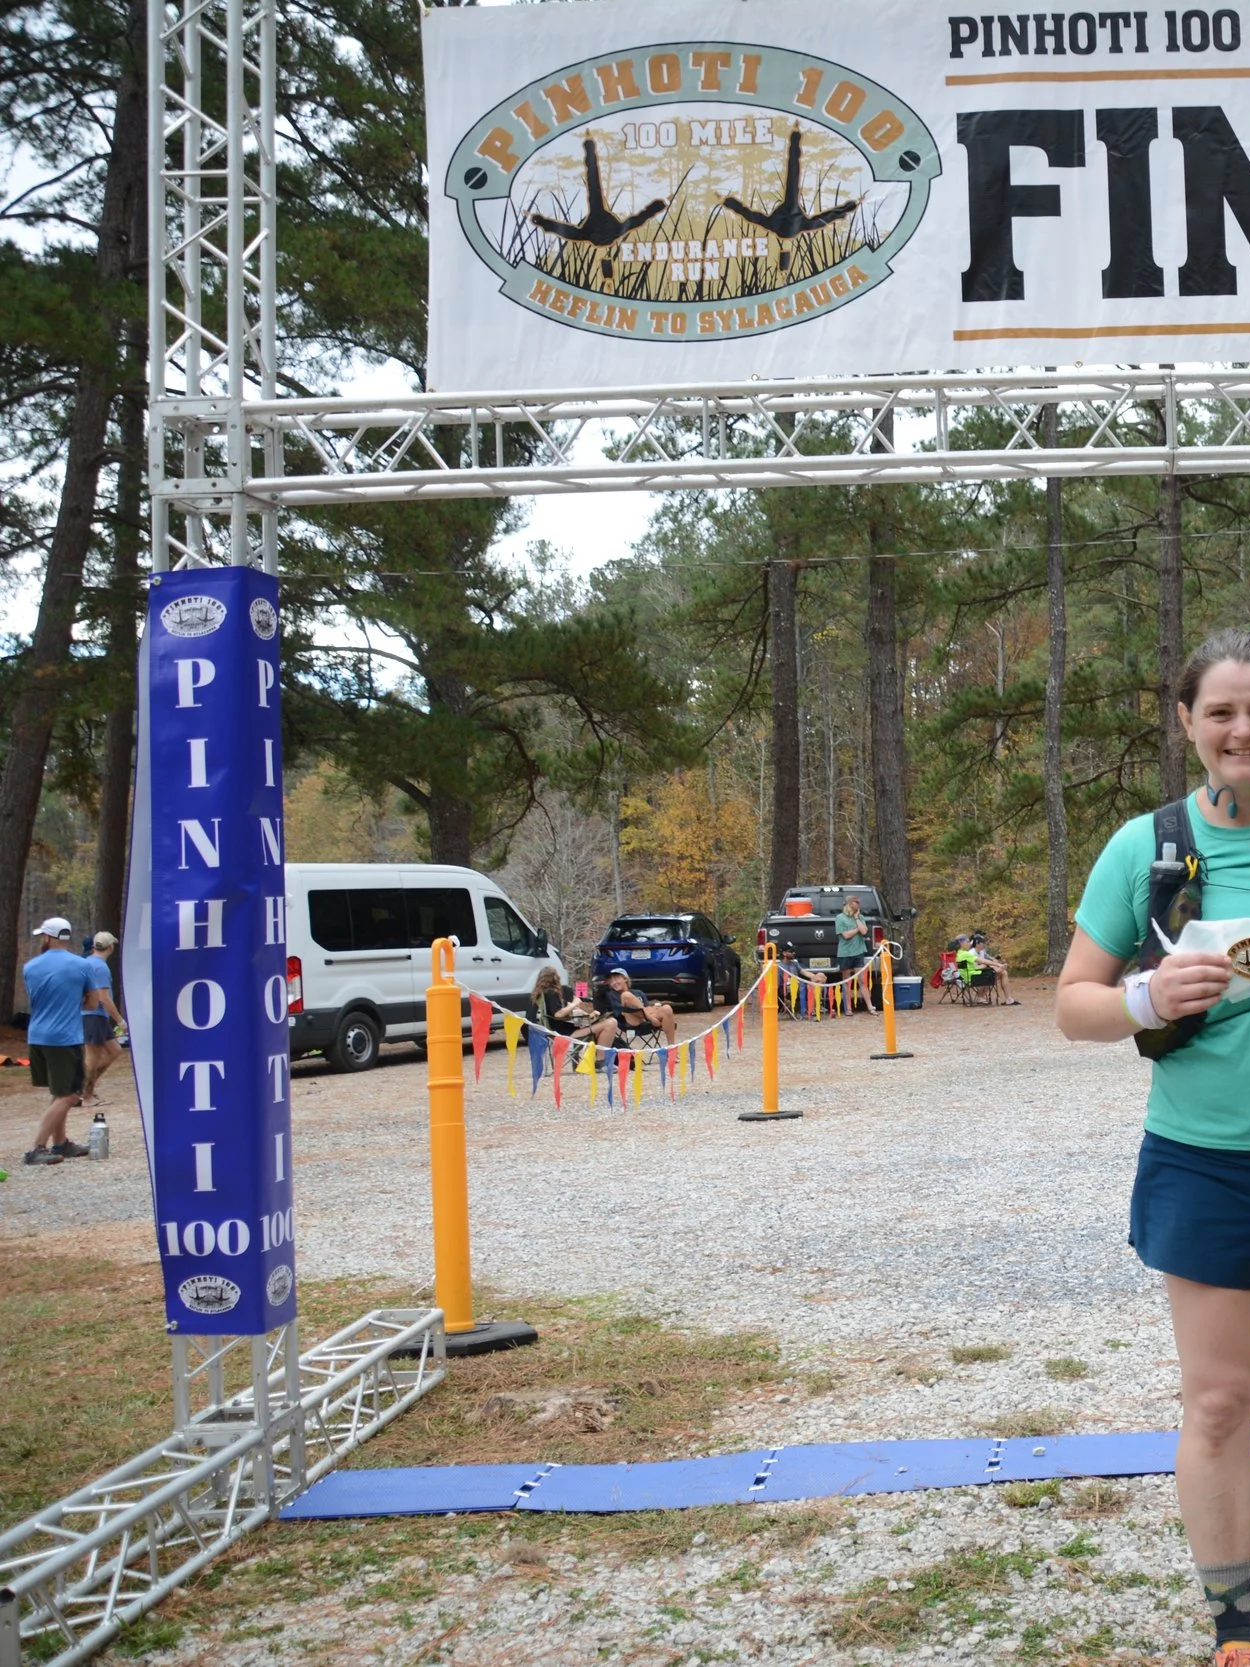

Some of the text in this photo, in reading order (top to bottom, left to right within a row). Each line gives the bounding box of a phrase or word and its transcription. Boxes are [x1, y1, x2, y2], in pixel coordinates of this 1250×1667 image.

[948, 12, 1148, 59] PINHOTI
[1165, 12, 1240, 54] 100
[475, 51, 907, 174] PINHOTI 100
[621, 118, 774, 150] 100 MILE
[620, 237, 769, 262] ENDURANCE
[670, 260, 721, 282] RUN
[528, 263, 869, 335] HEFLIN TO SYLACAUGA
[173, 657, 229, 1193] PINHOTI
[257, 658, 288, 1183] PINHOTI
[161, 1219, 251, 1257] 100
[260, 1206, 295, 1253] 100
